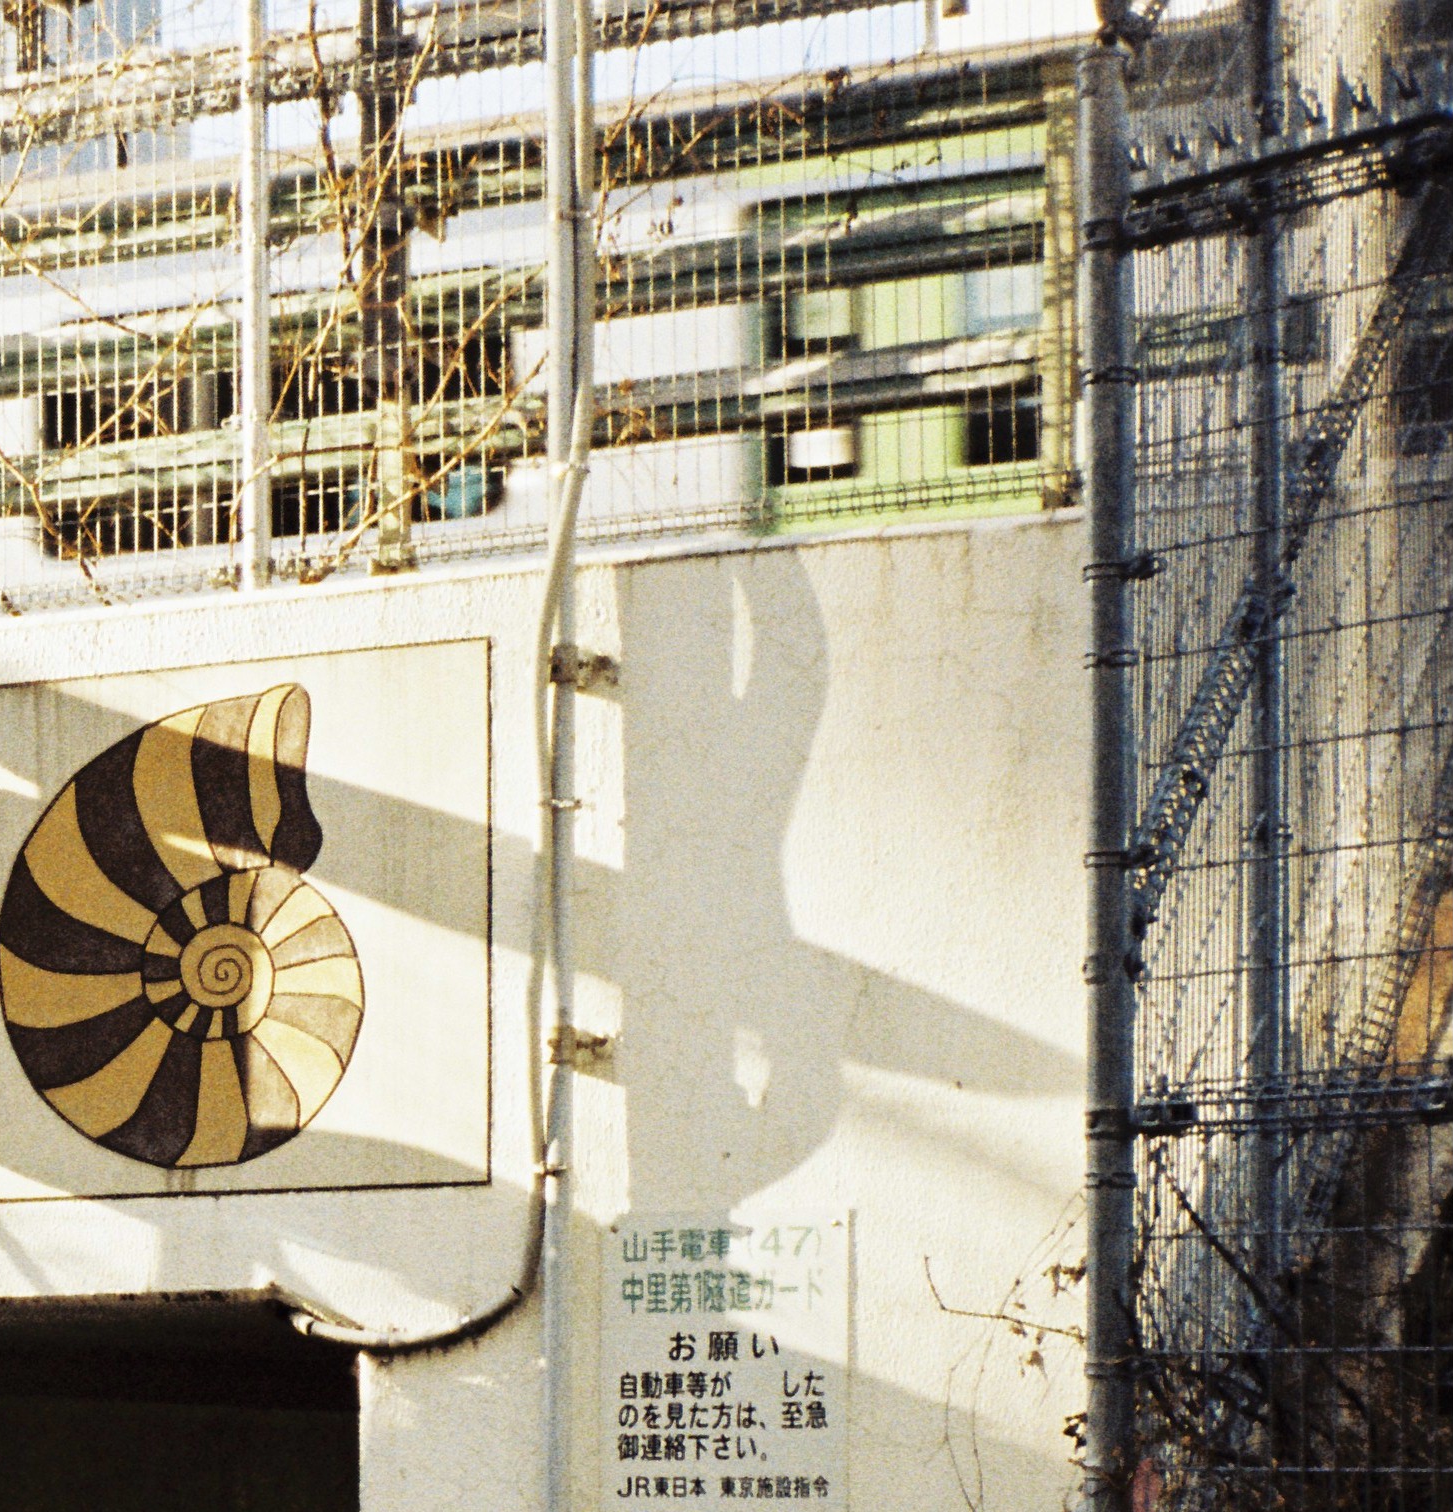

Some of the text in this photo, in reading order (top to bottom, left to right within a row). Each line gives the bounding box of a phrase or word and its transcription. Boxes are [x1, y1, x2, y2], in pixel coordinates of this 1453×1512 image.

[668, 1331, 780, 1362] お願い
[617, 1475, 707, 1499] JR東日本
